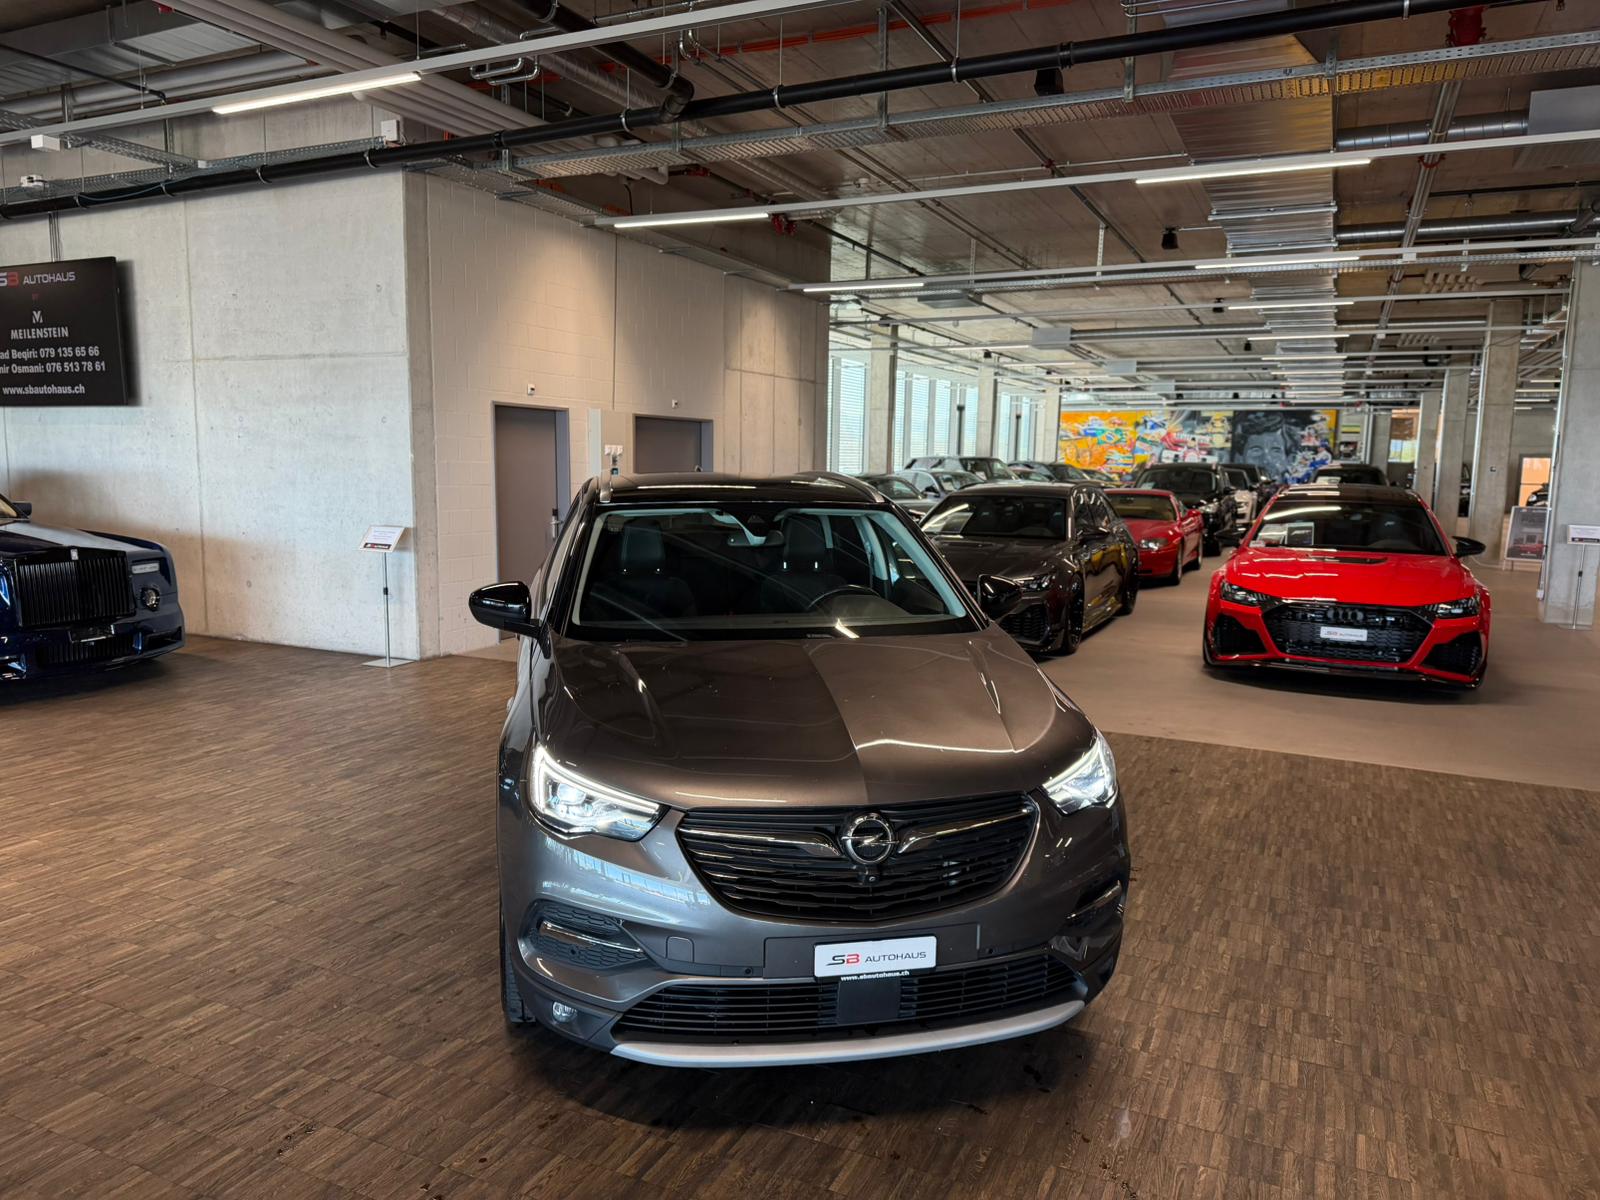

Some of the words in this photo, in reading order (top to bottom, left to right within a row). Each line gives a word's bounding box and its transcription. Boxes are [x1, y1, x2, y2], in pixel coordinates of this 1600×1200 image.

[23, 272, 76, 285] AUTOHAUS
[10, 326, 69, 340] MEILENSTEIN
[11, 348, 38, 361] Beqiri:
[39, 347, 55, 358] 079
[57, 346, 73, 357] 135
[75, 346, 86, 357] 65
[88, 346, 100, 357] 66
[11, 362, 45, 374] Osmani:
[46, 362, 62, 373] 076
[64, 361, 80, 372] 513
[82, 361, 93, 372] 78
[95, 361, 106, 372] 61
[2, 383, 86, 395] www.sbautohaus.ch
[825, 953, 861, 966] SB
[864, 951, 927, 963] AUTOHAUS
